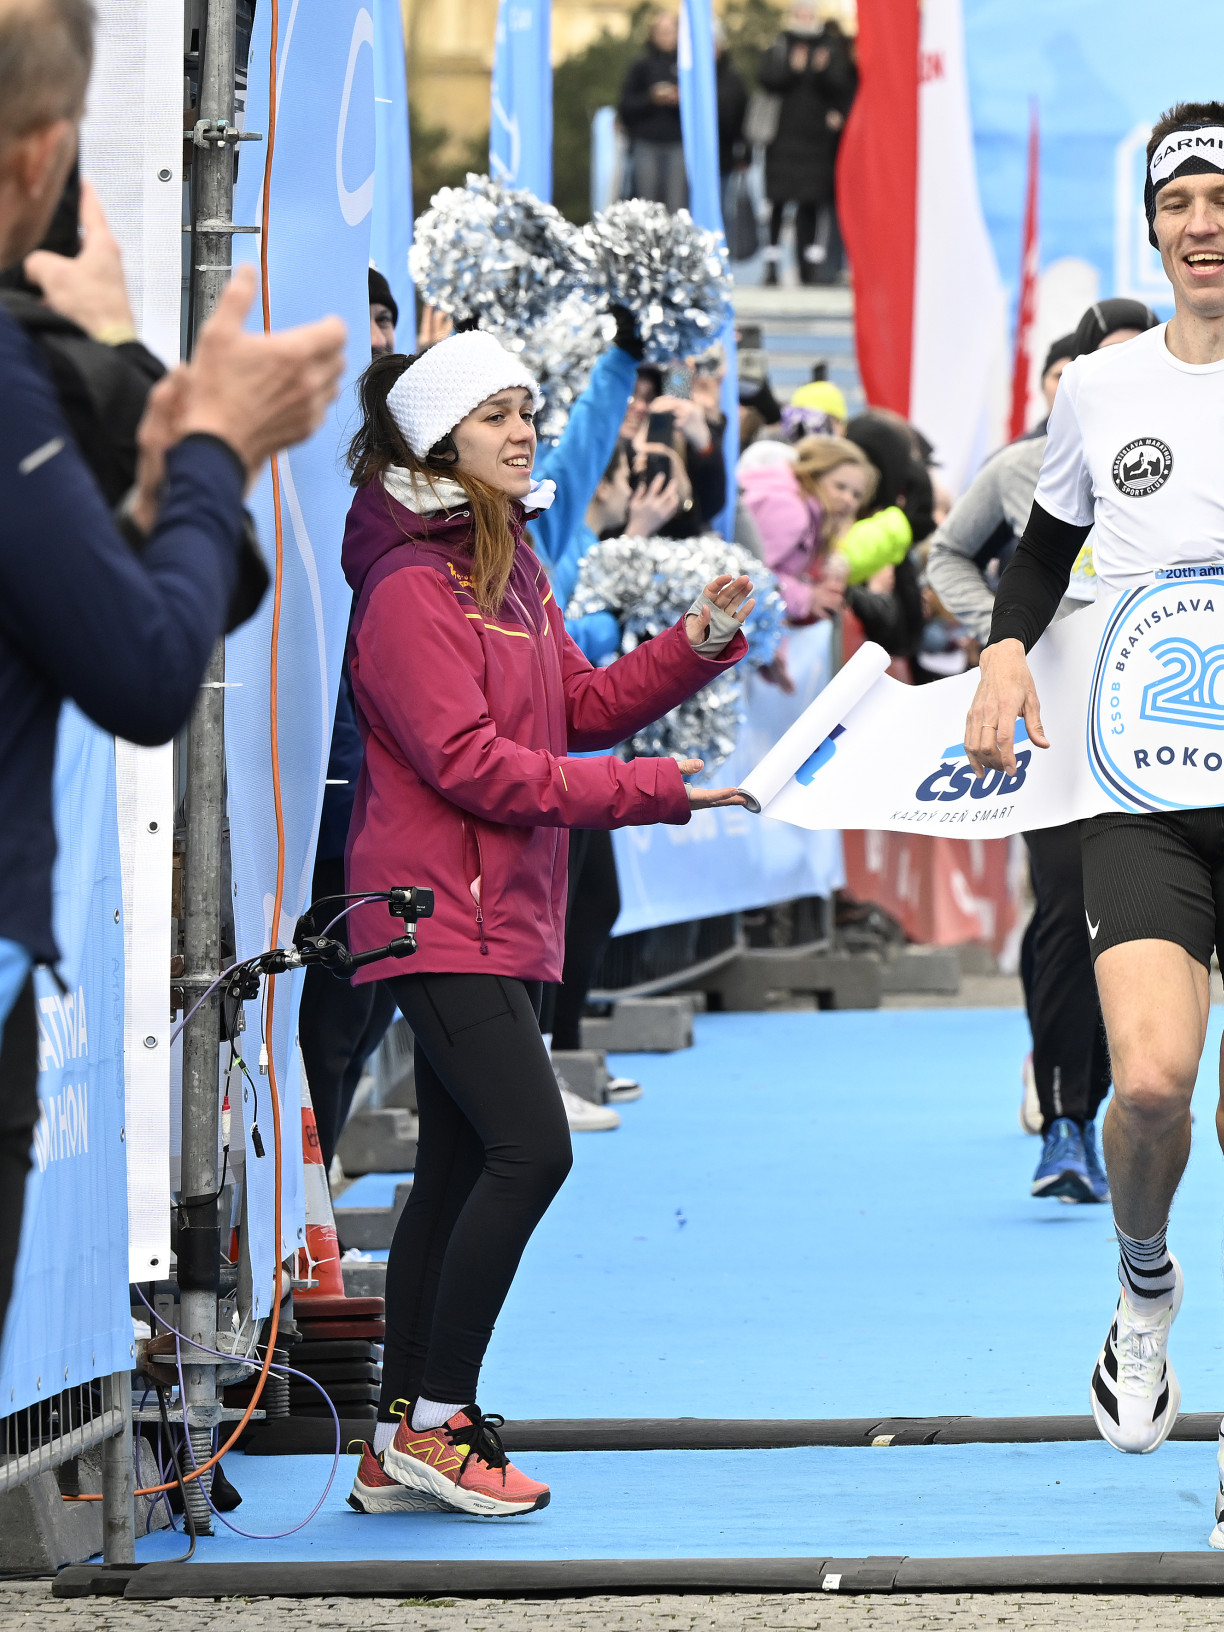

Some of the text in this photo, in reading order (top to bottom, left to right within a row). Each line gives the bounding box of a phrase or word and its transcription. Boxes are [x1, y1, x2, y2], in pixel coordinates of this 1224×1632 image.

[1113, 439, 1171, 475] BRATISLAVA MARATHON
[1121, 477, 1164, 496] SPORT CLUB
[1165, 567, 1197, 579] 20th
[1115, 599, 1215, 672] BRATISLAVA
[1110, 682, 1125, 735] ČSOB
[915, 749, 1032, 801] ČSOB
[889, 805, 1015, 823] KAŽDÝ DEŇ SMART
